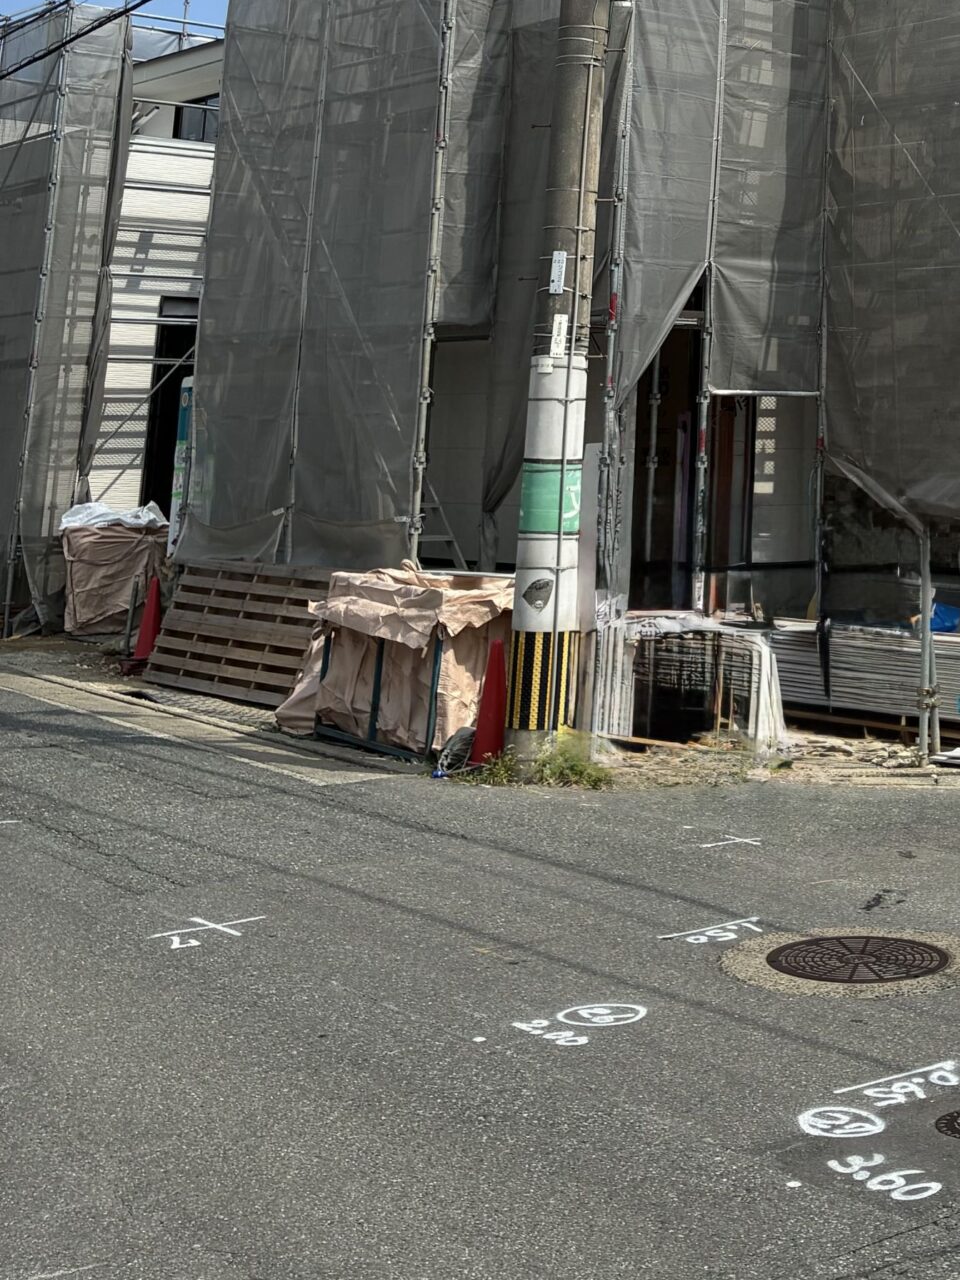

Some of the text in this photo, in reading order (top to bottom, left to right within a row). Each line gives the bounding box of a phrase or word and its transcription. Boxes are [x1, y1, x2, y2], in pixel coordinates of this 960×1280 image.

[685, 923, 763, 944] 1.50
[511, 1019, 589, 1046] 2.00
[862, 1070, 960, 1107] 0.65
[826, 1152, 943, 1201] 3.60
